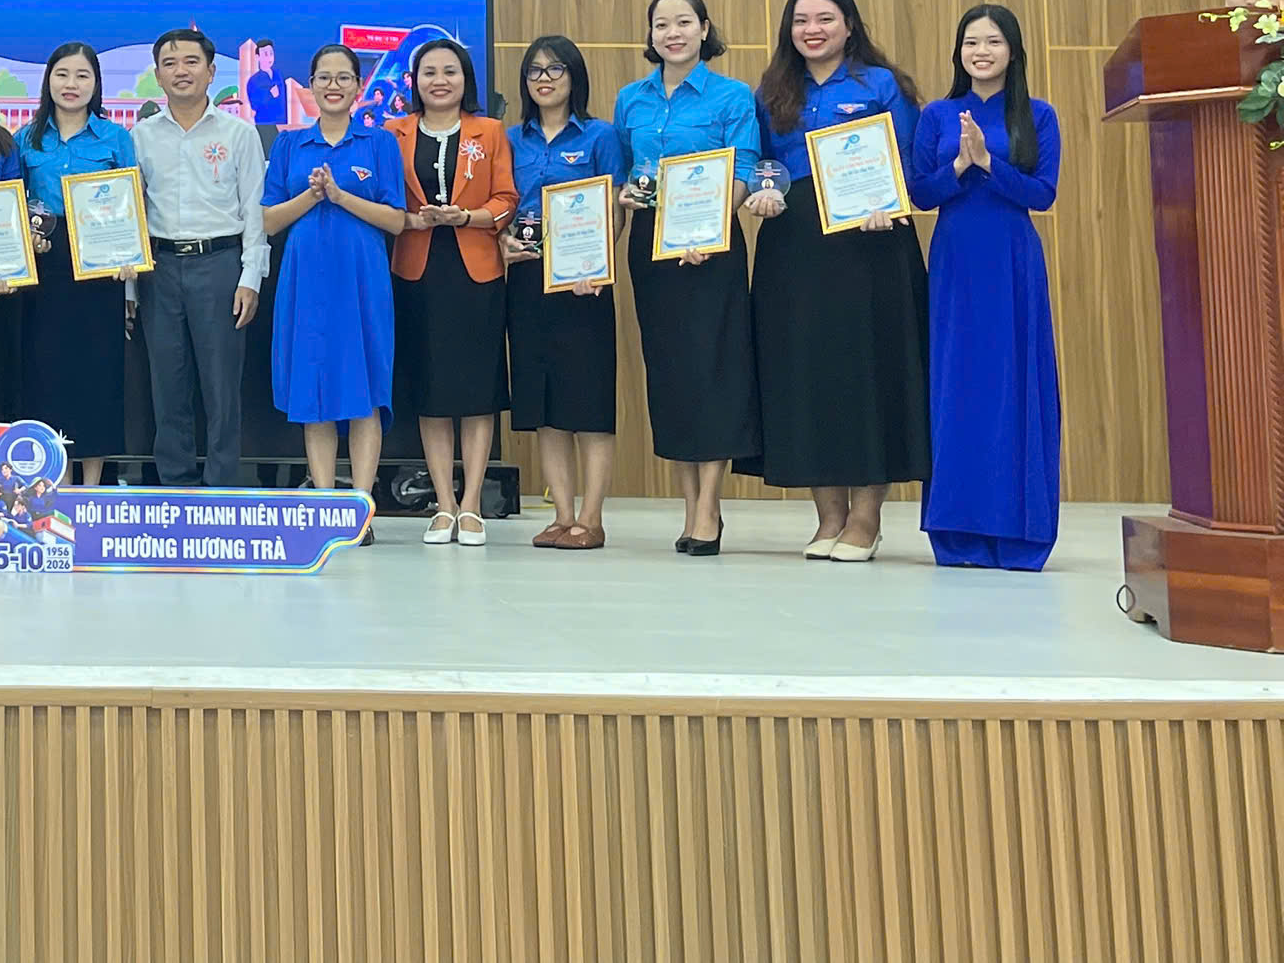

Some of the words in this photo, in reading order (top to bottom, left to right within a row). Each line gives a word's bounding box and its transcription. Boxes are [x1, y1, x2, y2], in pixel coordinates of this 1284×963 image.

[75, 500, 102, 528] HỘI
[106, 500, 141, 525] LIÊN
[145, 501, 181, 529] HIỆP
[184, 505, 236, 525] THANH
[240, 503, 279, 527] NIÊN
[282, 503, 316, 531] VIỆT
[319, 507, 357, 528] NAM
[46, 546, 70, 557] 1956
[101, 532, 178, 559] PHƯỜNG
[182, 536, 246, 560] HƯƠNG
[250, 535, 287, 561] TRÀ
[46, 559, 71, 570] 2026
